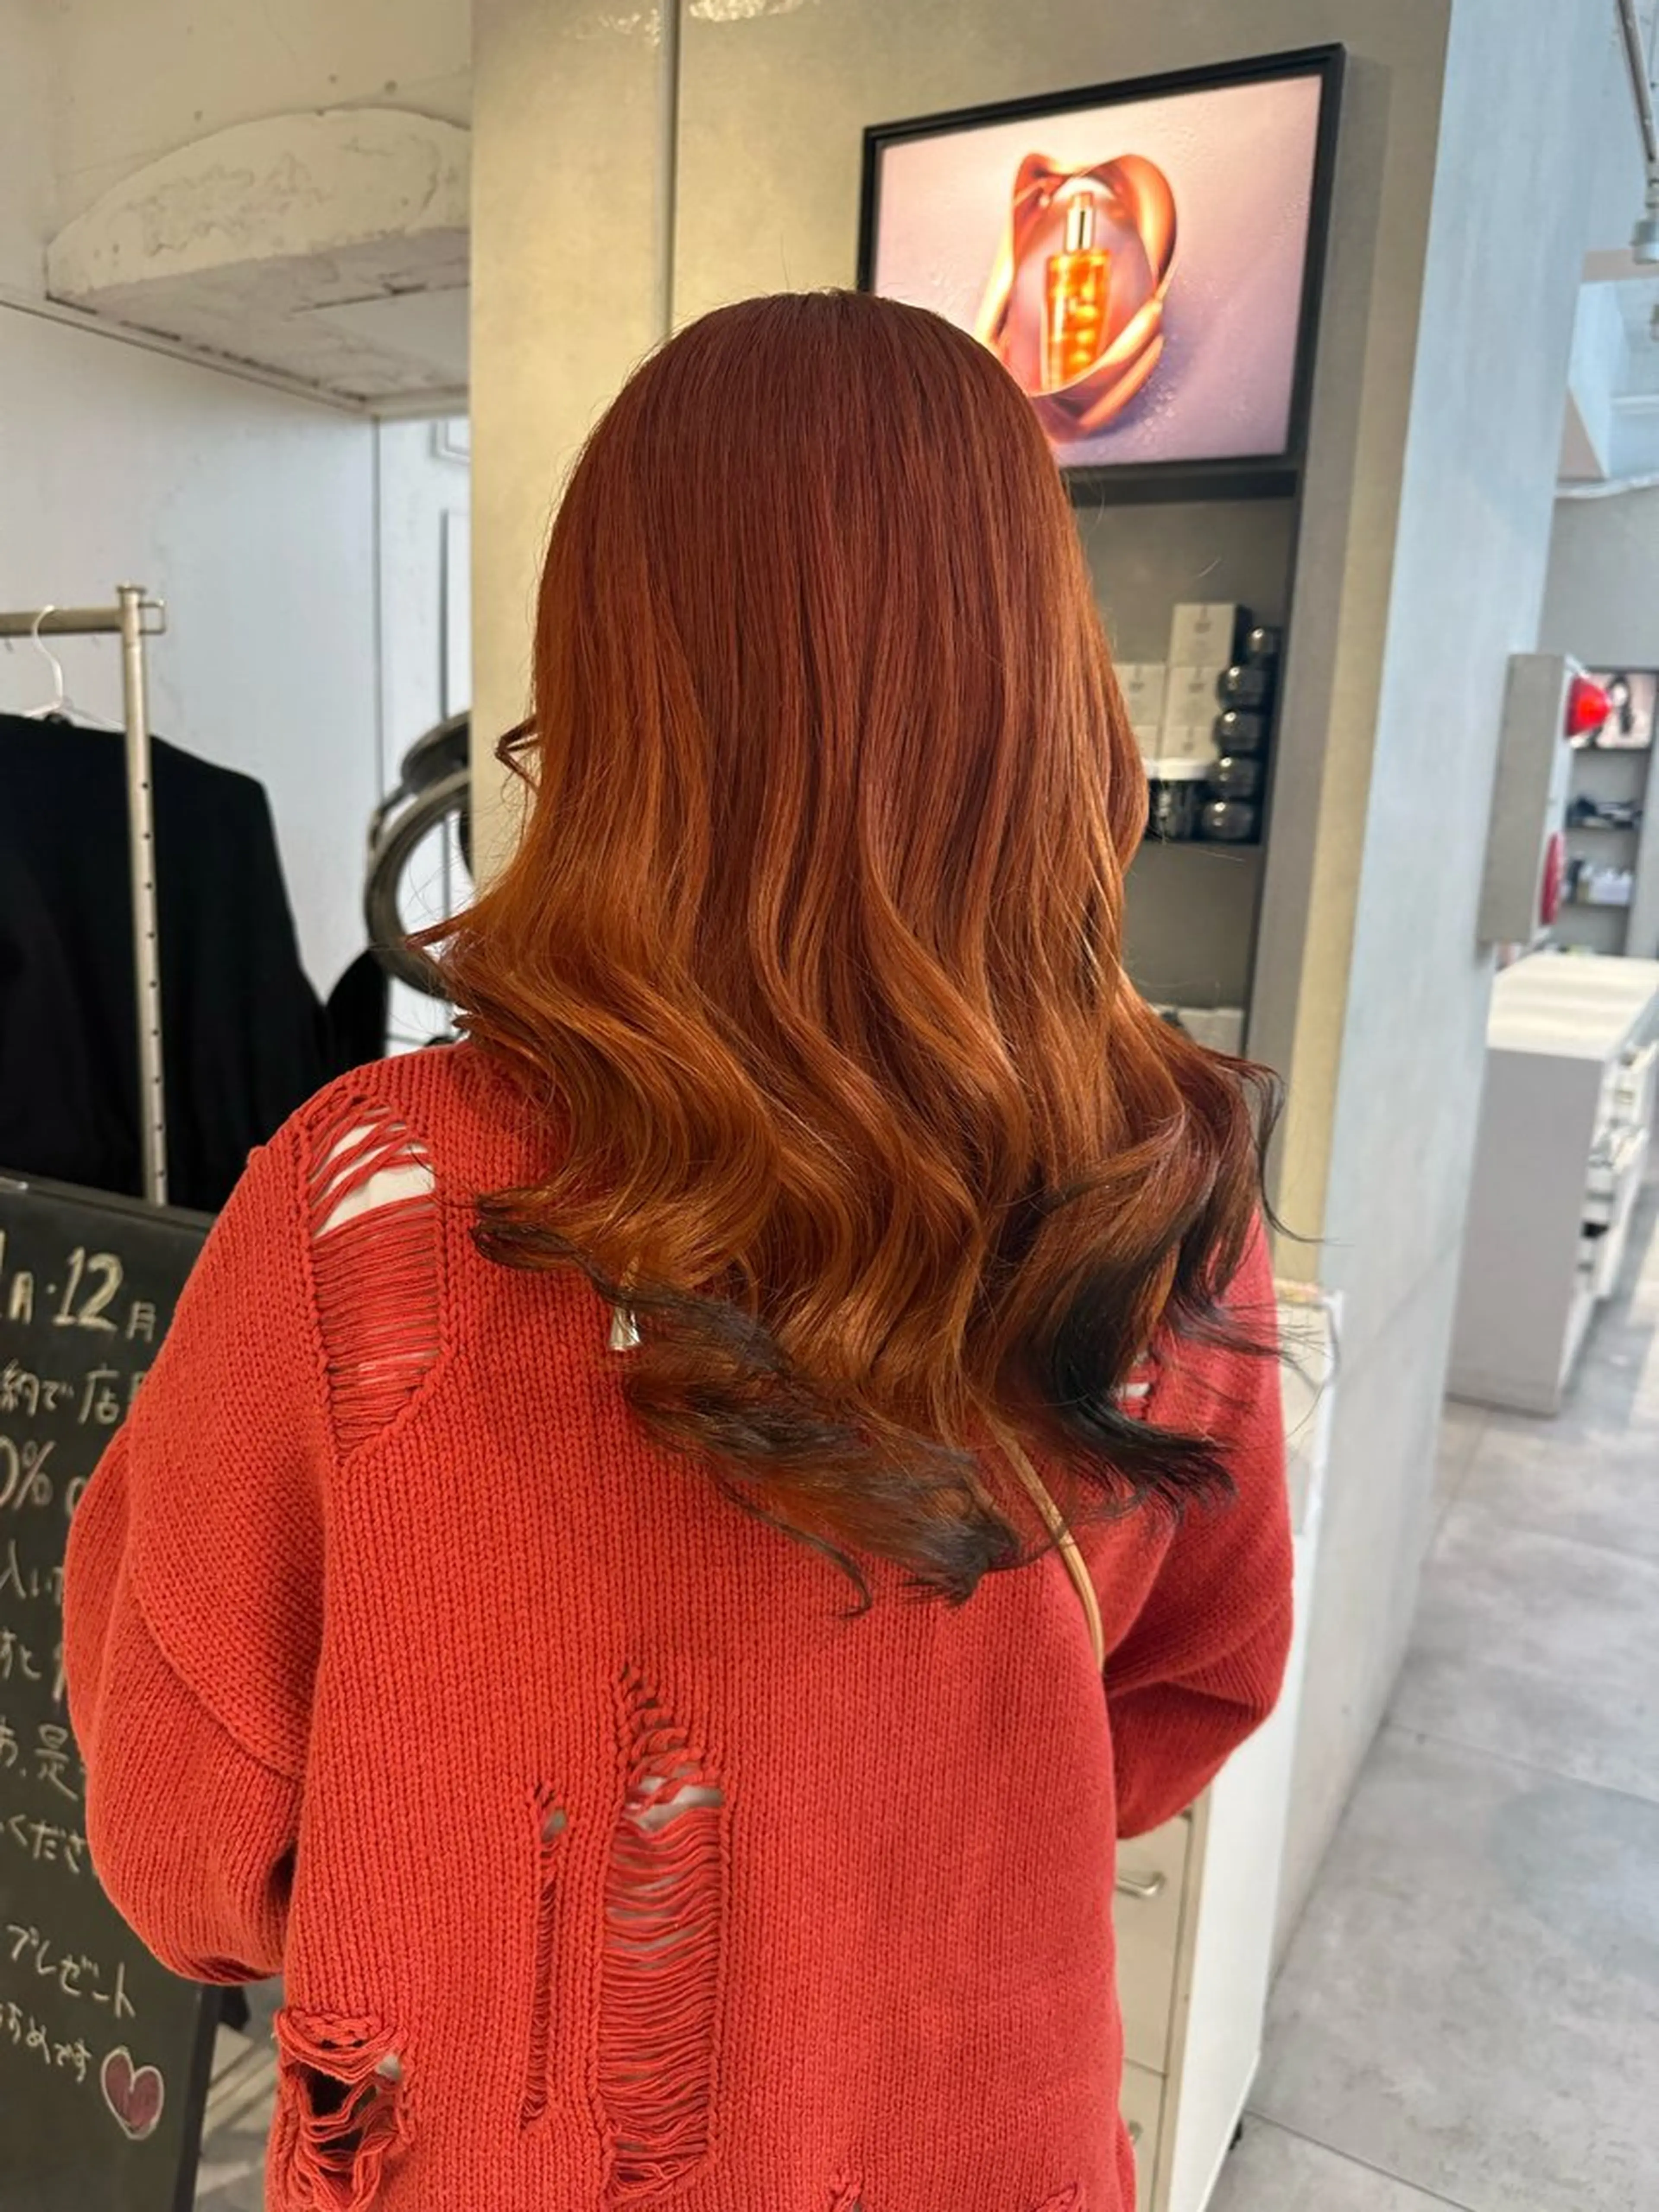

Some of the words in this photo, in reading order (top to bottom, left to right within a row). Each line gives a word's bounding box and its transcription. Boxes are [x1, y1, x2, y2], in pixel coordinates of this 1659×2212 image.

[0, 1359, 144, 1425] 約で店
[0, 2001, 92, 2083] すめです
